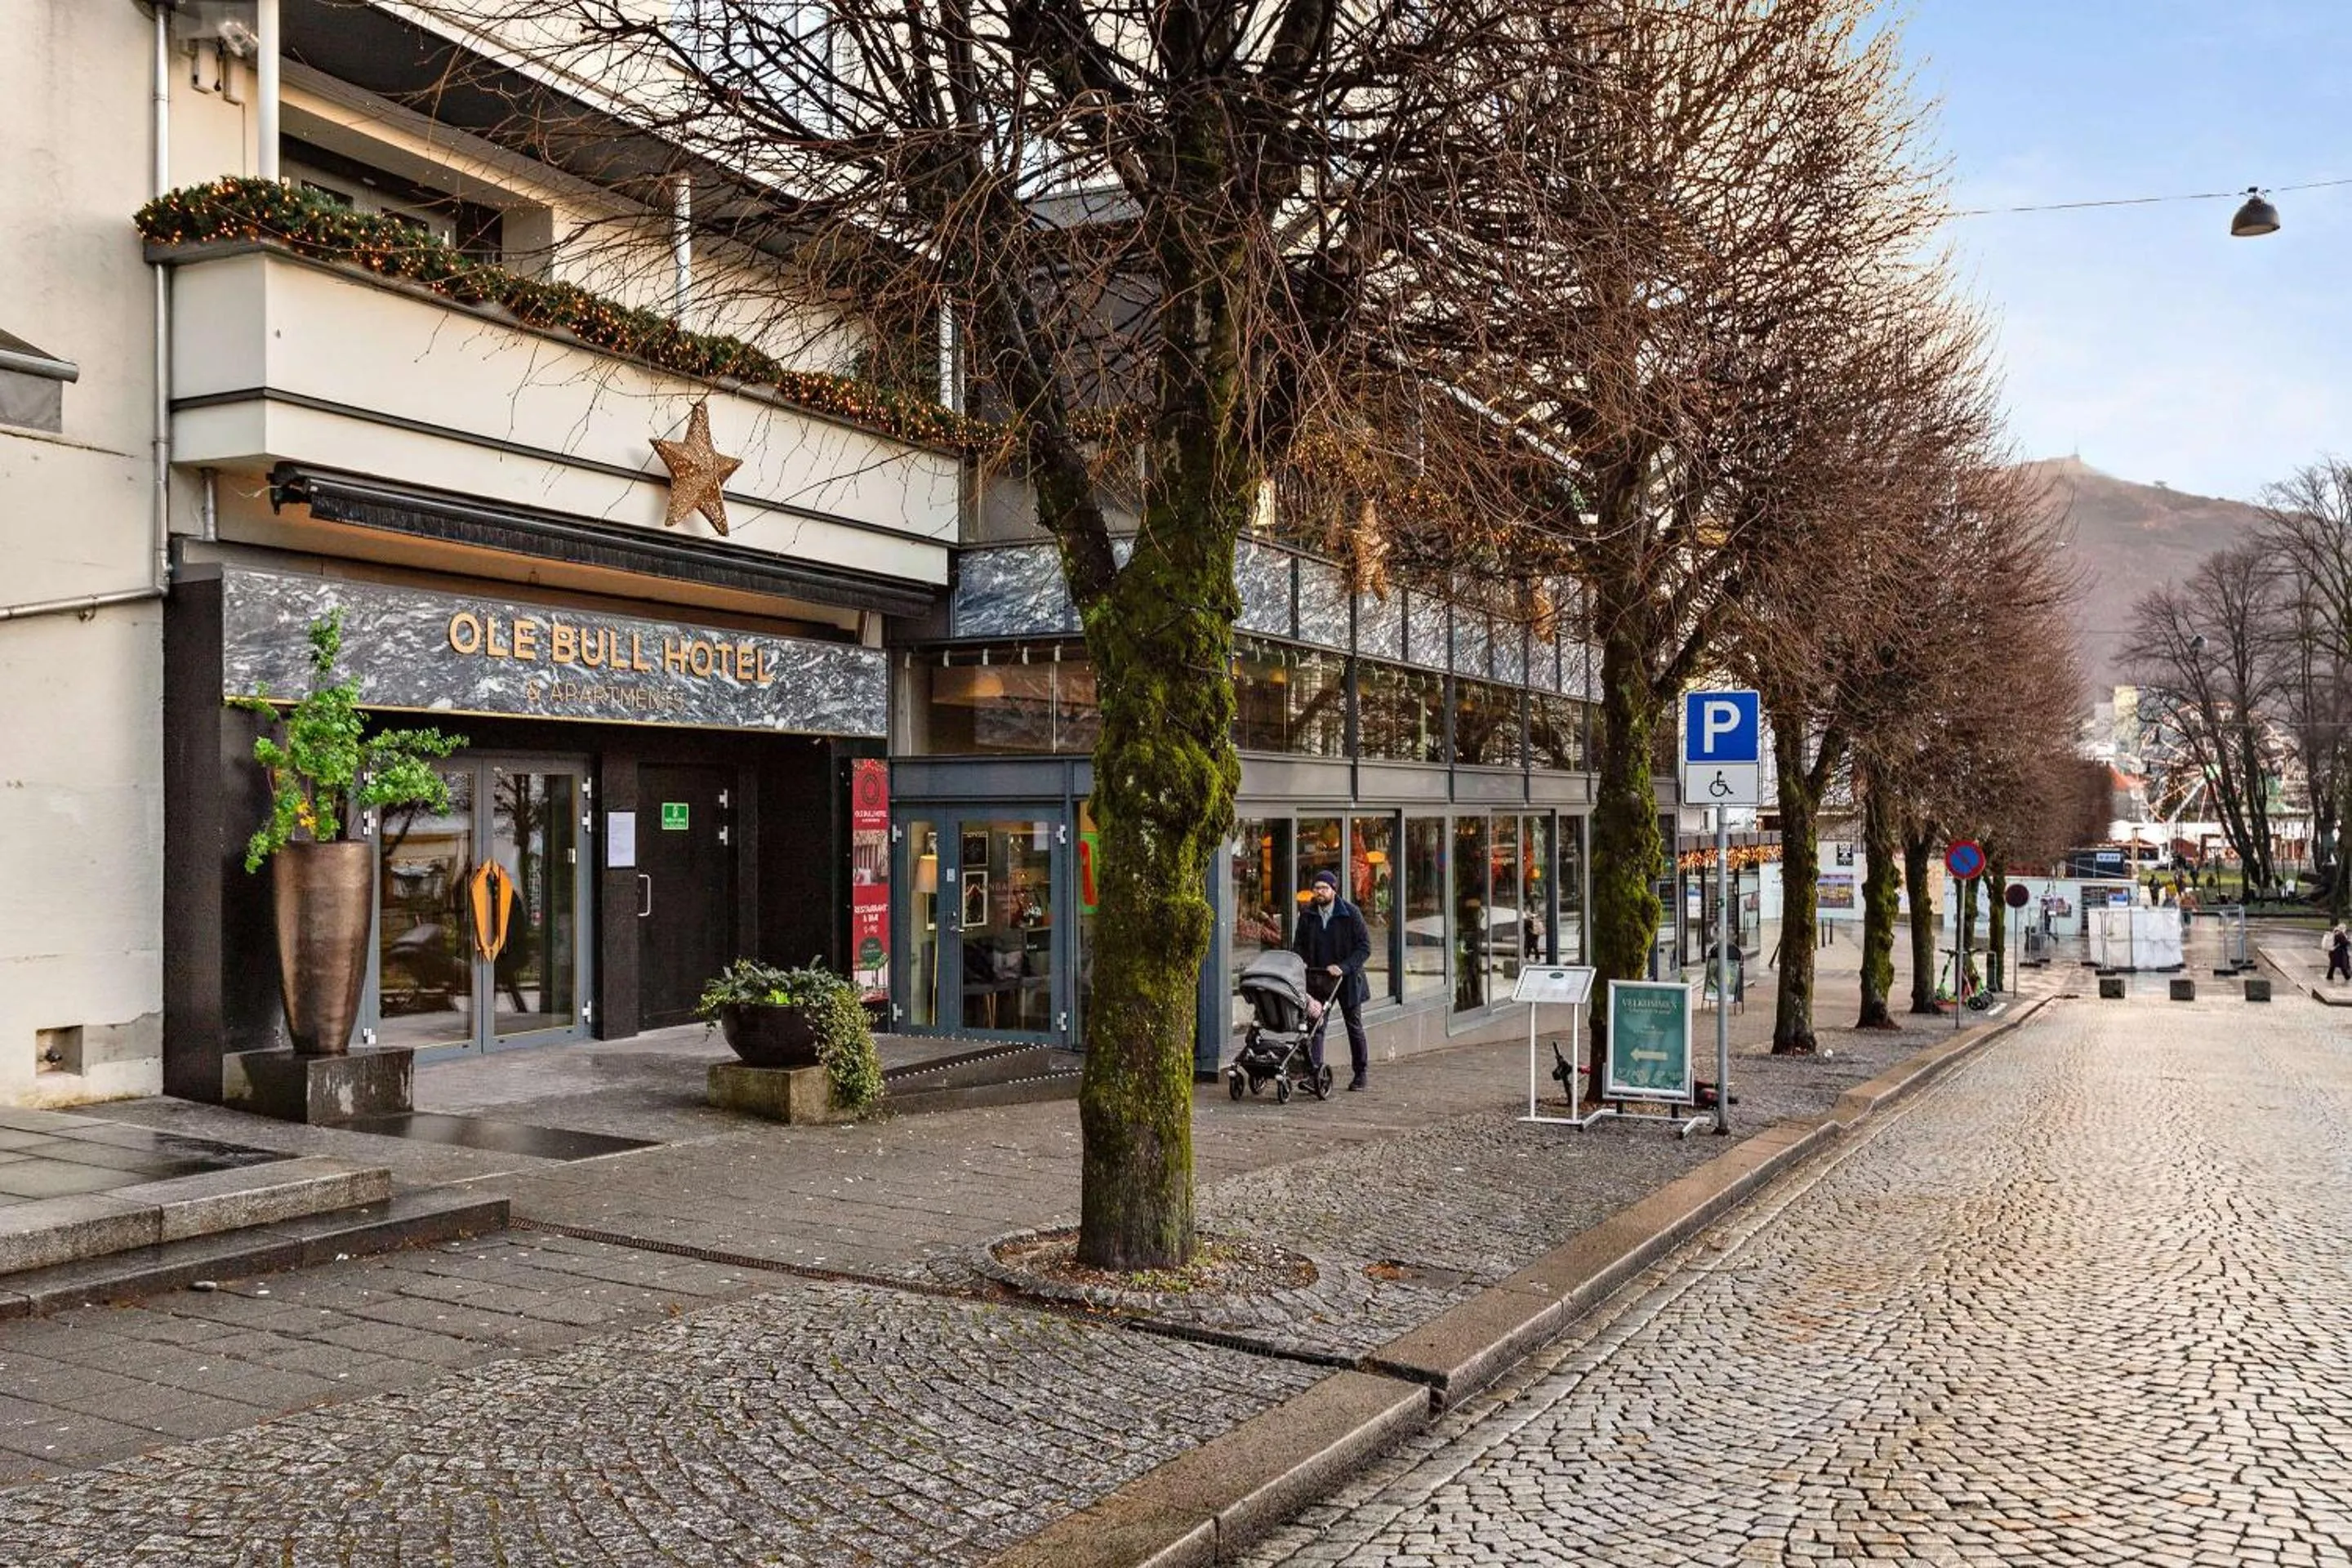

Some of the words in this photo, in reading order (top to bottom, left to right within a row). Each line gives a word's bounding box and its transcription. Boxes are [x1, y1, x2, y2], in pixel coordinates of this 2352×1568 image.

[448, 611, 537, 661] OLE
[550, 623, 652, 673] BULL
[663, 637, 776, 684] HOTEL
[524, 679, 541, 701] &
[550, 682, 687, 710] APARTMENTS
[1704, 701, 1741, 753] P
